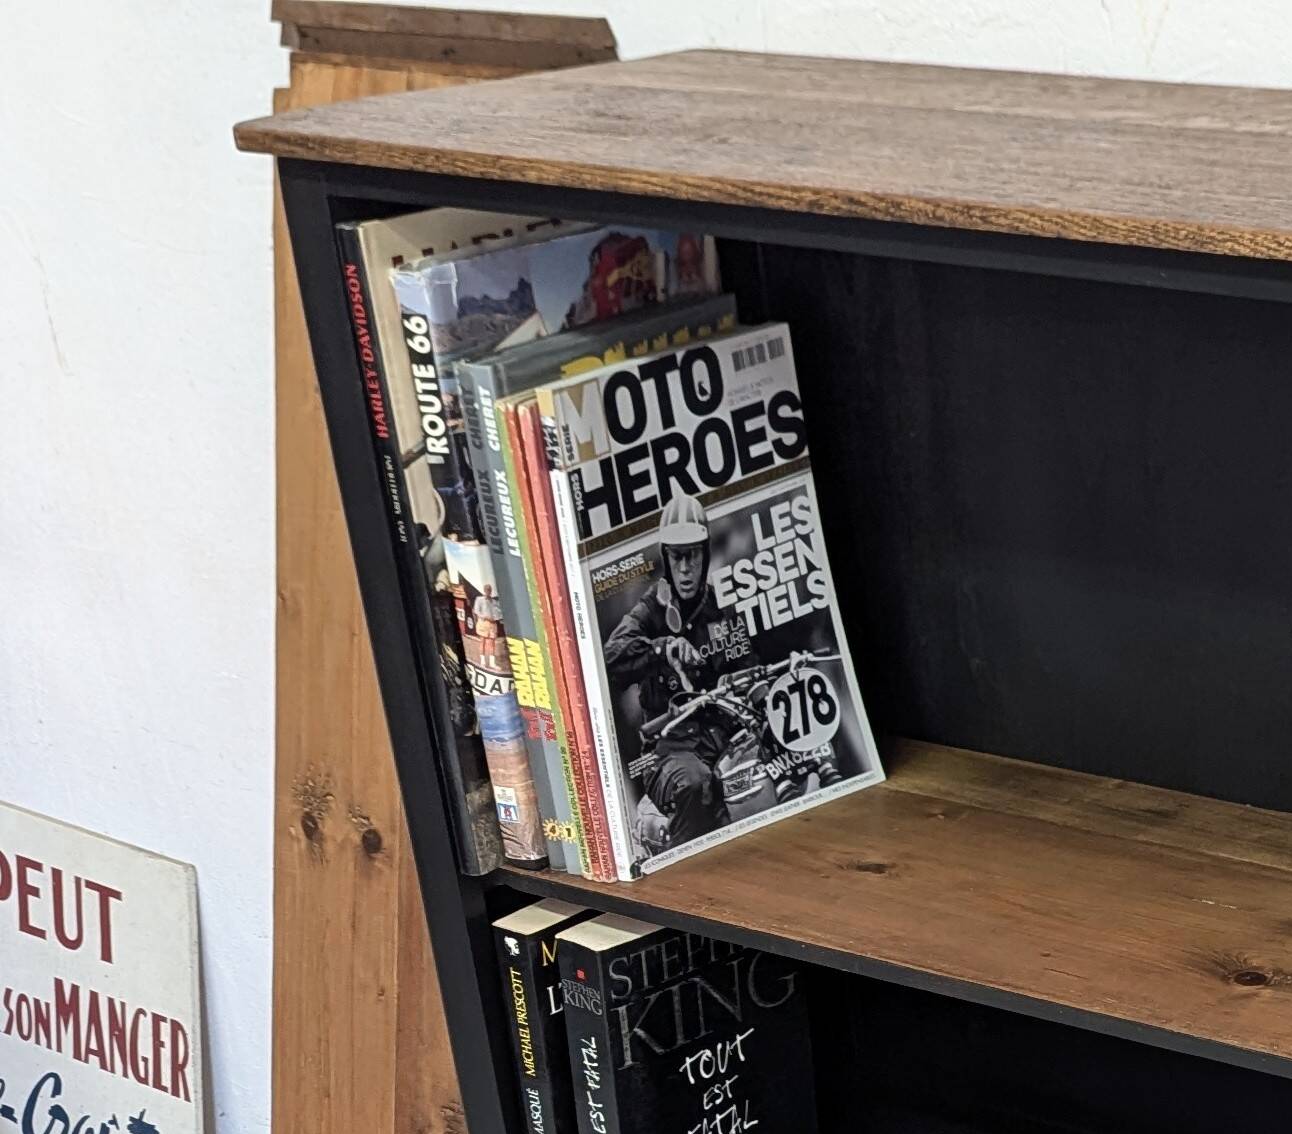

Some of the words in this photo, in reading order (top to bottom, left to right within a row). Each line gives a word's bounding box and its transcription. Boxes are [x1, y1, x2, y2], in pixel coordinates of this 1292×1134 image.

[402, 315, 431, 354] 66
[556, 346, 724, 460] MOTO
[568, 391, 808, 540] HEROES
[751, 495, 815, 551] LES
[711, 532, 824, 609] ESSEN
[713, 621, 730, 639] DE
[731, 616, 746, 634] LA
[735, 570, 829, 637] TIELS
[701, 629, 749, 658] CULTURE
[725, 643, 750, 662] RIDE
[771, 673, 837, 744] 278
[508, 966, 529, 1025] PRESCOTT
[561, 978, 601, 1001] STEPHEN
[563, 988, 603, 1016] KING
[609, 951, 799, 1071] KING
[3, 987, 53, 1051] SON
[54, 976, 191, 1103] MANGER
[518, 1026, 537, 1077] MICHAEL
[580, 1036, 601, 1090] FATAL
[679, 1027, 755, 1085] TOUT
[587, 1091, 607, 1134] EST
[703, 1074, 739, 1110] EST
